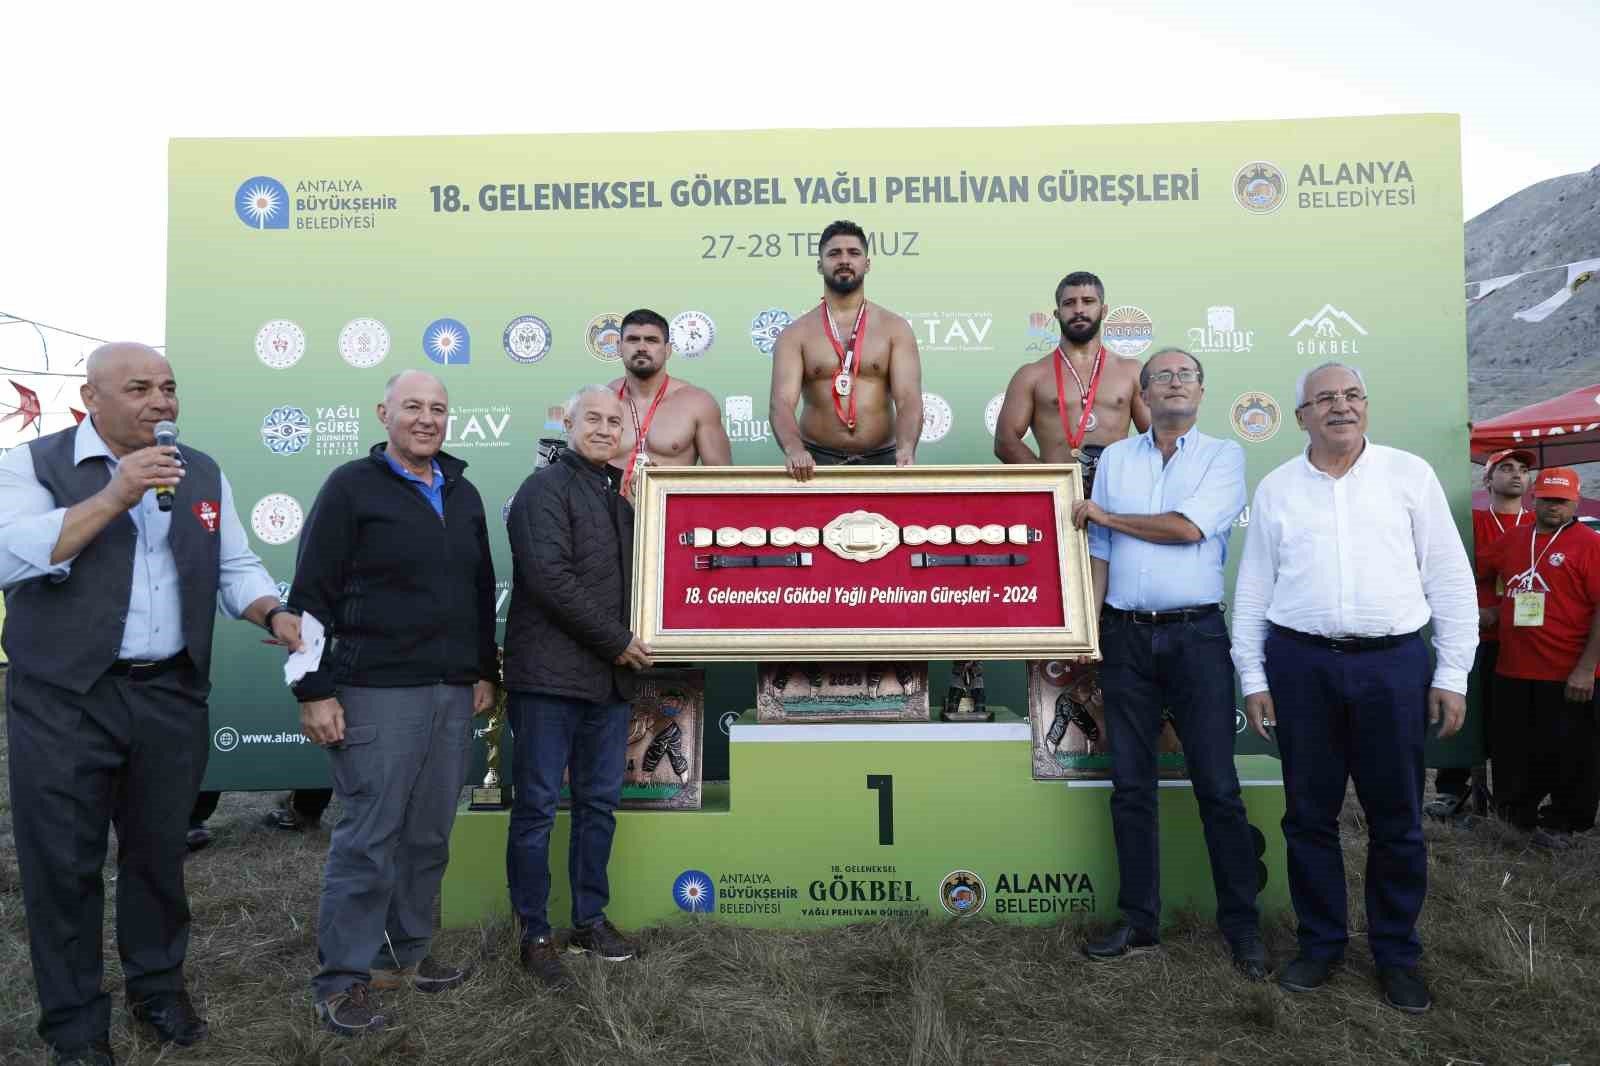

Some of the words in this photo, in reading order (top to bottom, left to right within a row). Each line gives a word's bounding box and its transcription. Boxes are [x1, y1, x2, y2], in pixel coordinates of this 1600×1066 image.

[1298, 161, 1413, 186] ALANYA
[296, 180, 363, 193] ANTALYA
[430, 184, 470, 213] 18.
[479, 181, 663, 213] GELENEKSEL
[670, 173, 787, 208] GÖKBEL
[794, 171, 876, 205] YAĞLI
[885, 170, 1030, 204] PEHLİVAN
[1038, 168, 1200, 207] GÜREŞLERİ
[296, 194, 397, 213] BÜYÜKŞEHİR
[1298, 186, 1416, 209] BELEDİYESİ
[296, 215, 375, 230] BELEDİYESİ
[701, 233, 782, 260] 27-28
[316, 405, 360, 419] YAĞLI
[315, 419, 360, 434] GÜREŞ
[685, 586, 704, 604] 18.
[707, 586, 780, 604] Geleneksel
[783, 586, 831, 604] Gökbel
[834, 586, 867, 607] Yağlı
[869, 585, 928, 604] Pehlivan
[930, 585, 991, 606] Güreşleri
[1002, 585, 1038, 603] 2024
[866, 774, 894, 845] 1
[845, 864, 897, 873] GELENEKSEL
[719, 873, 772, 884] ANTALYA
[995, 873, 1094, 893] ALANYA
[719, 885, 798, 901] BÜYÜKŞEHİR
[808, 874, 920, 902] GÖKBEL
[719, 902, 781, 914] BELEDİYESİ
[801, 905, 830, 917] YAĞLI
[832, 906, 877, 917] PEHLİVAN
[995, 895, 1096, 913] BELEDİYESİ
